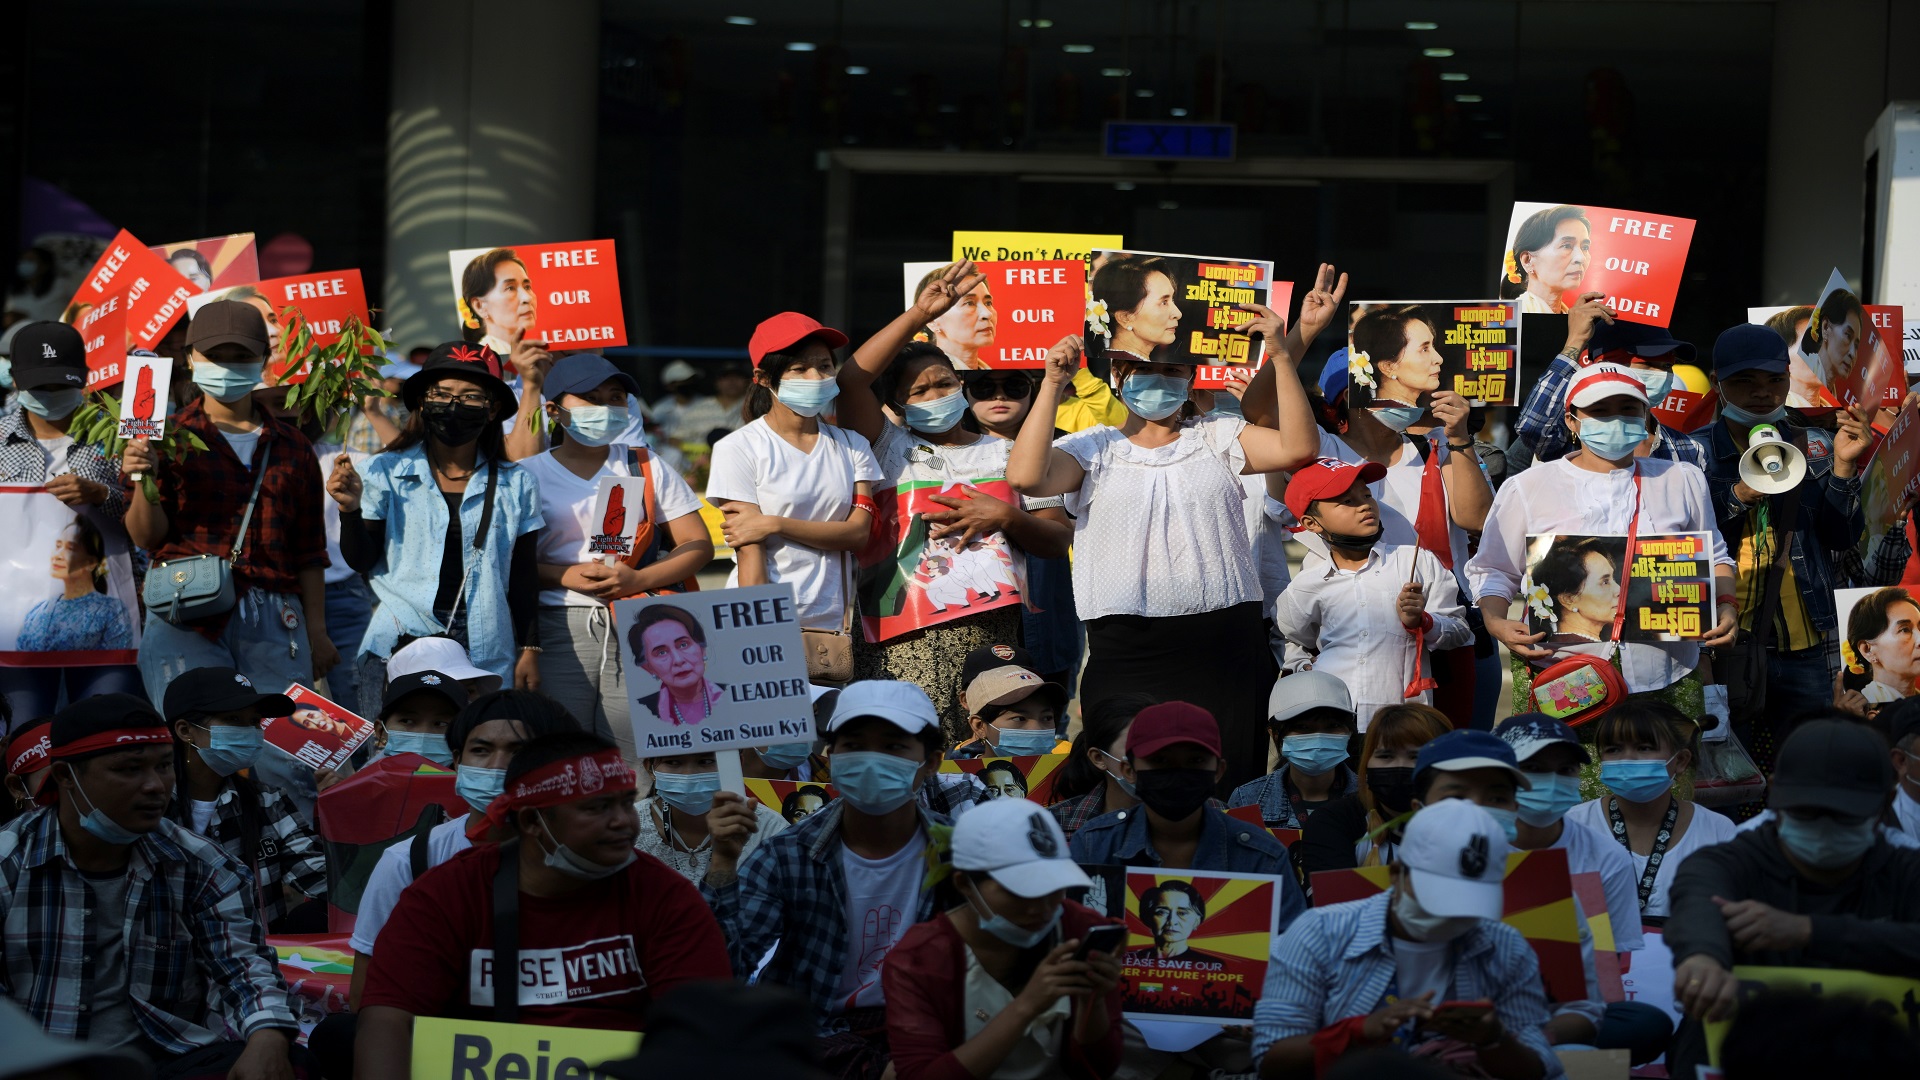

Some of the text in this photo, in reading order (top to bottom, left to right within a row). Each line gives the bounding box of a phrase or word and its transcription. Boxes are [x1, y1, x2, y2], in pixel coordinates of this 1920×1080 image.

[1113, 127, 1227, 156] EXIT
[1609, 217, 1674, 241] FREE
[540, 249, 599, 269] FREE
[962, 247, 990, 261] We
[1053, 248, 1091, 263] Acce
[90, 245, 131, 294] FREE
[1005, 268, 1067, 285] FREE
[1605, 257, 1650, 276] OUR
[284, 278, 347, 301] FREE
[549, 290, 591, 306] OUR
[82, 296, 119, 331] FREE
[138, 286, 191, 342] LEADER
[1011, 309, 1055, 323] OUR
[1595, 296, 1661, 318] ADER
[1871, 312, 1892, 328] EE
[541, 326, 615, 344] LEADER
[1000, 348, 1048, 362] LEAD
[86, 362, 119, 387] DER
[1652, 396, 1688, 413] EE
[1887, 412, 1912, 452] FREE
[1892, 450, 1910, 477] OUR
[712, 597, 794, 630] FREE
[742, 644, 784, 665] OUR
[730, 678, 806, 703] LEADER
[646, 718, 808, 749] Aung San Suu Kyi
[295, 739, 332, 768] FREE
[481, 958, 560, 987] RSE
[1121, 956, 1223, 971] LEASE SAVE OUR
[1148, 969, 1200, 981] FUTURE
[1207, 972, 1244, 983] HOPE
[535, 986, 592, 1000] STREET STYLE
[451, 1033, 608, 1080] Reje
